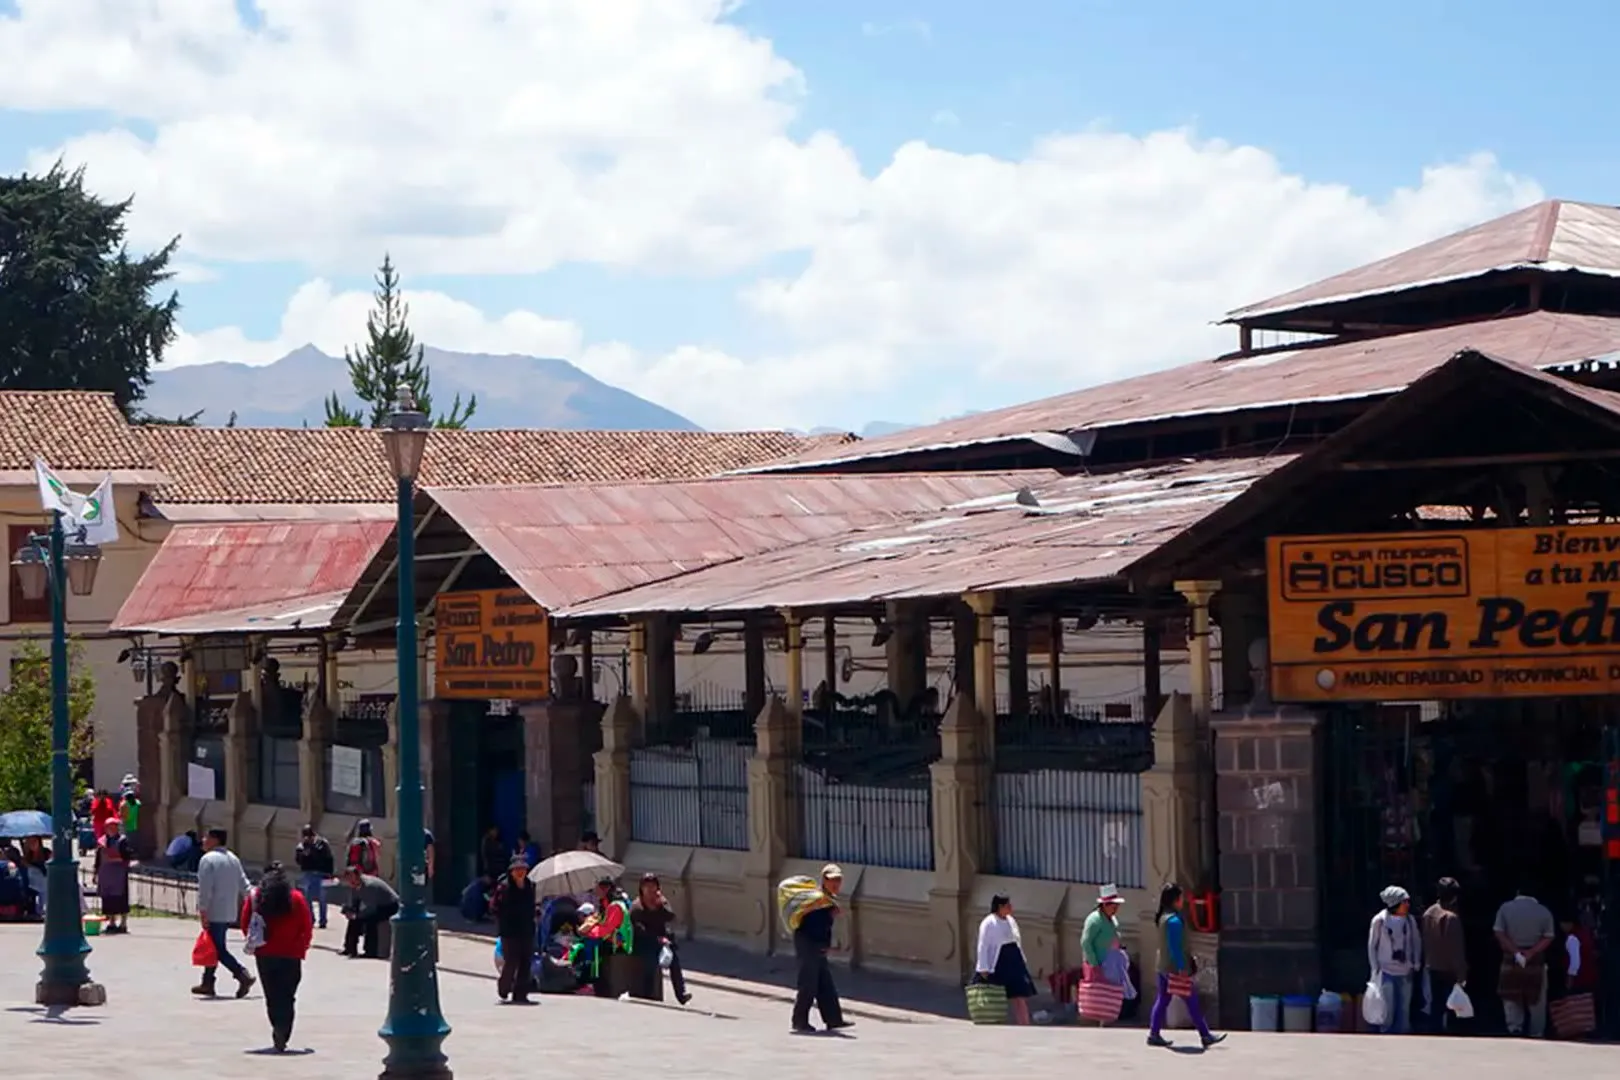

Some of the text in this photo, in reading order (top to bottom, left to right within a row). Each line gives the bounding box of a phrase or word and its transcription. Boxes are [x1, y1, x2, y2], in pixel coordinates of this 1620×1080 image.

[1525, 568, 1543, 585] a
[1551, 563, 1582, 584] tu
[1314, 601, 1450, 652] San
[1344, 669, 1483, 687] MUNICIPALIDAD
[1493, 666, 1600, 684] PROVINCIAL
